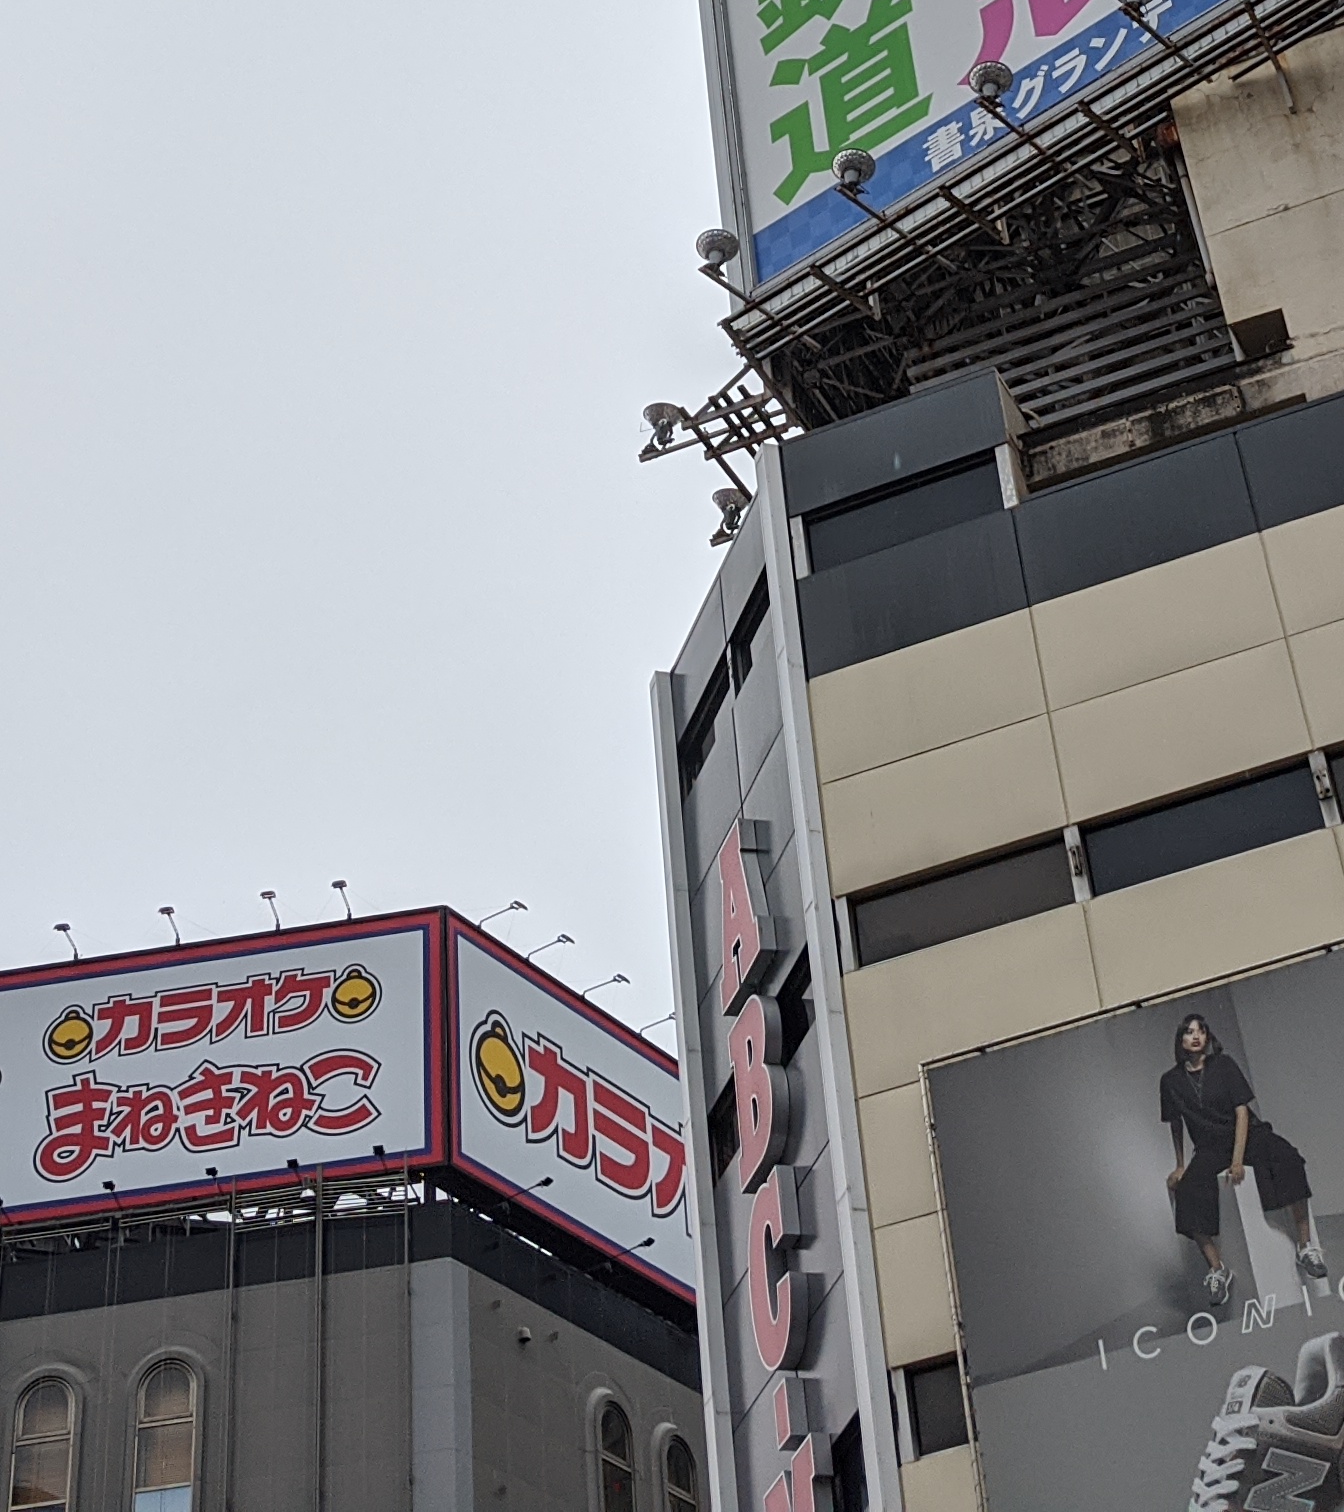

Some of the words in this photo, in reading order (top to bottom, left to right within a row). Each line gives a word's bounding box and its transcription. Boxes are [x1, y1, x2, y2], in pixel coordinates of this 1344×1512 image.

[93, 970, 332, 1058] カラオケ
[36, 1052, 380, 1182] まねきねこ
